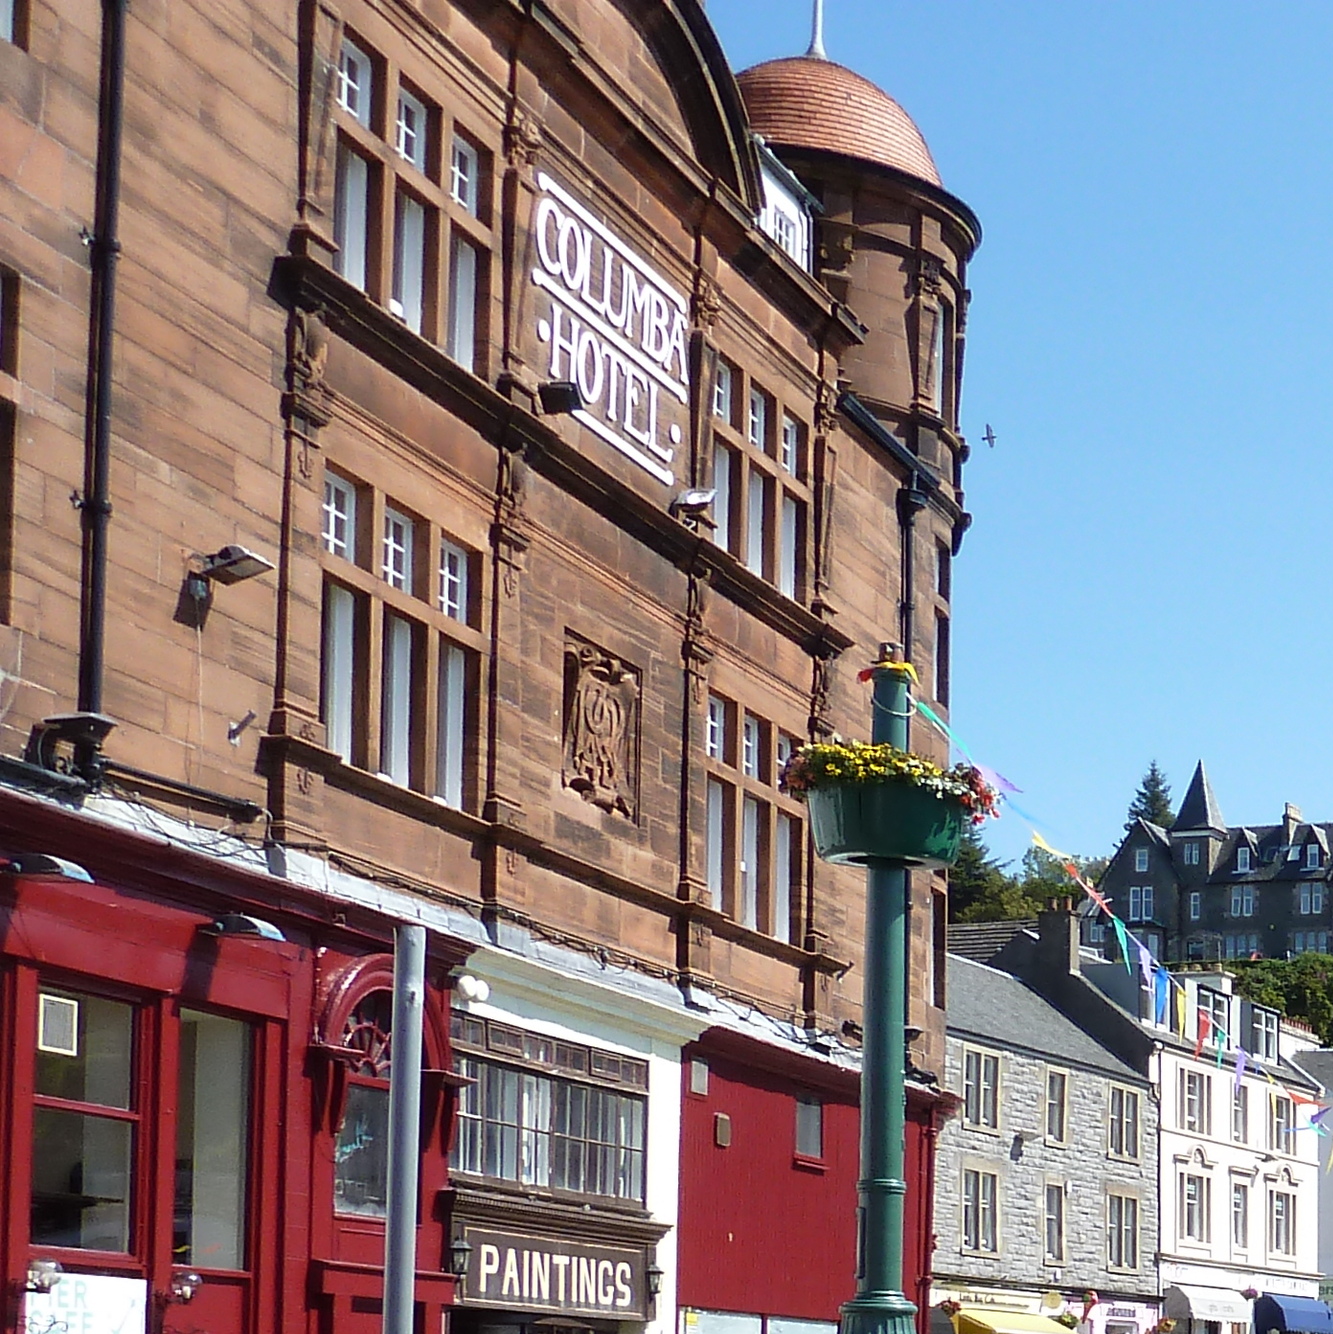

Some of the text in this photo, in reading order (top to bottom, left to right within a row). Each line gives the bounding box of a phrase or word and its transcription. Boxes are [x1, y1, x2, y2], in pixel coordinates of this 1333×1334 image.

[536, 198, 690, 385] COLUMBA
[550, 303, 675, 463] HOTEL
[479, 1243, 632, 1307] PAINTINGS
